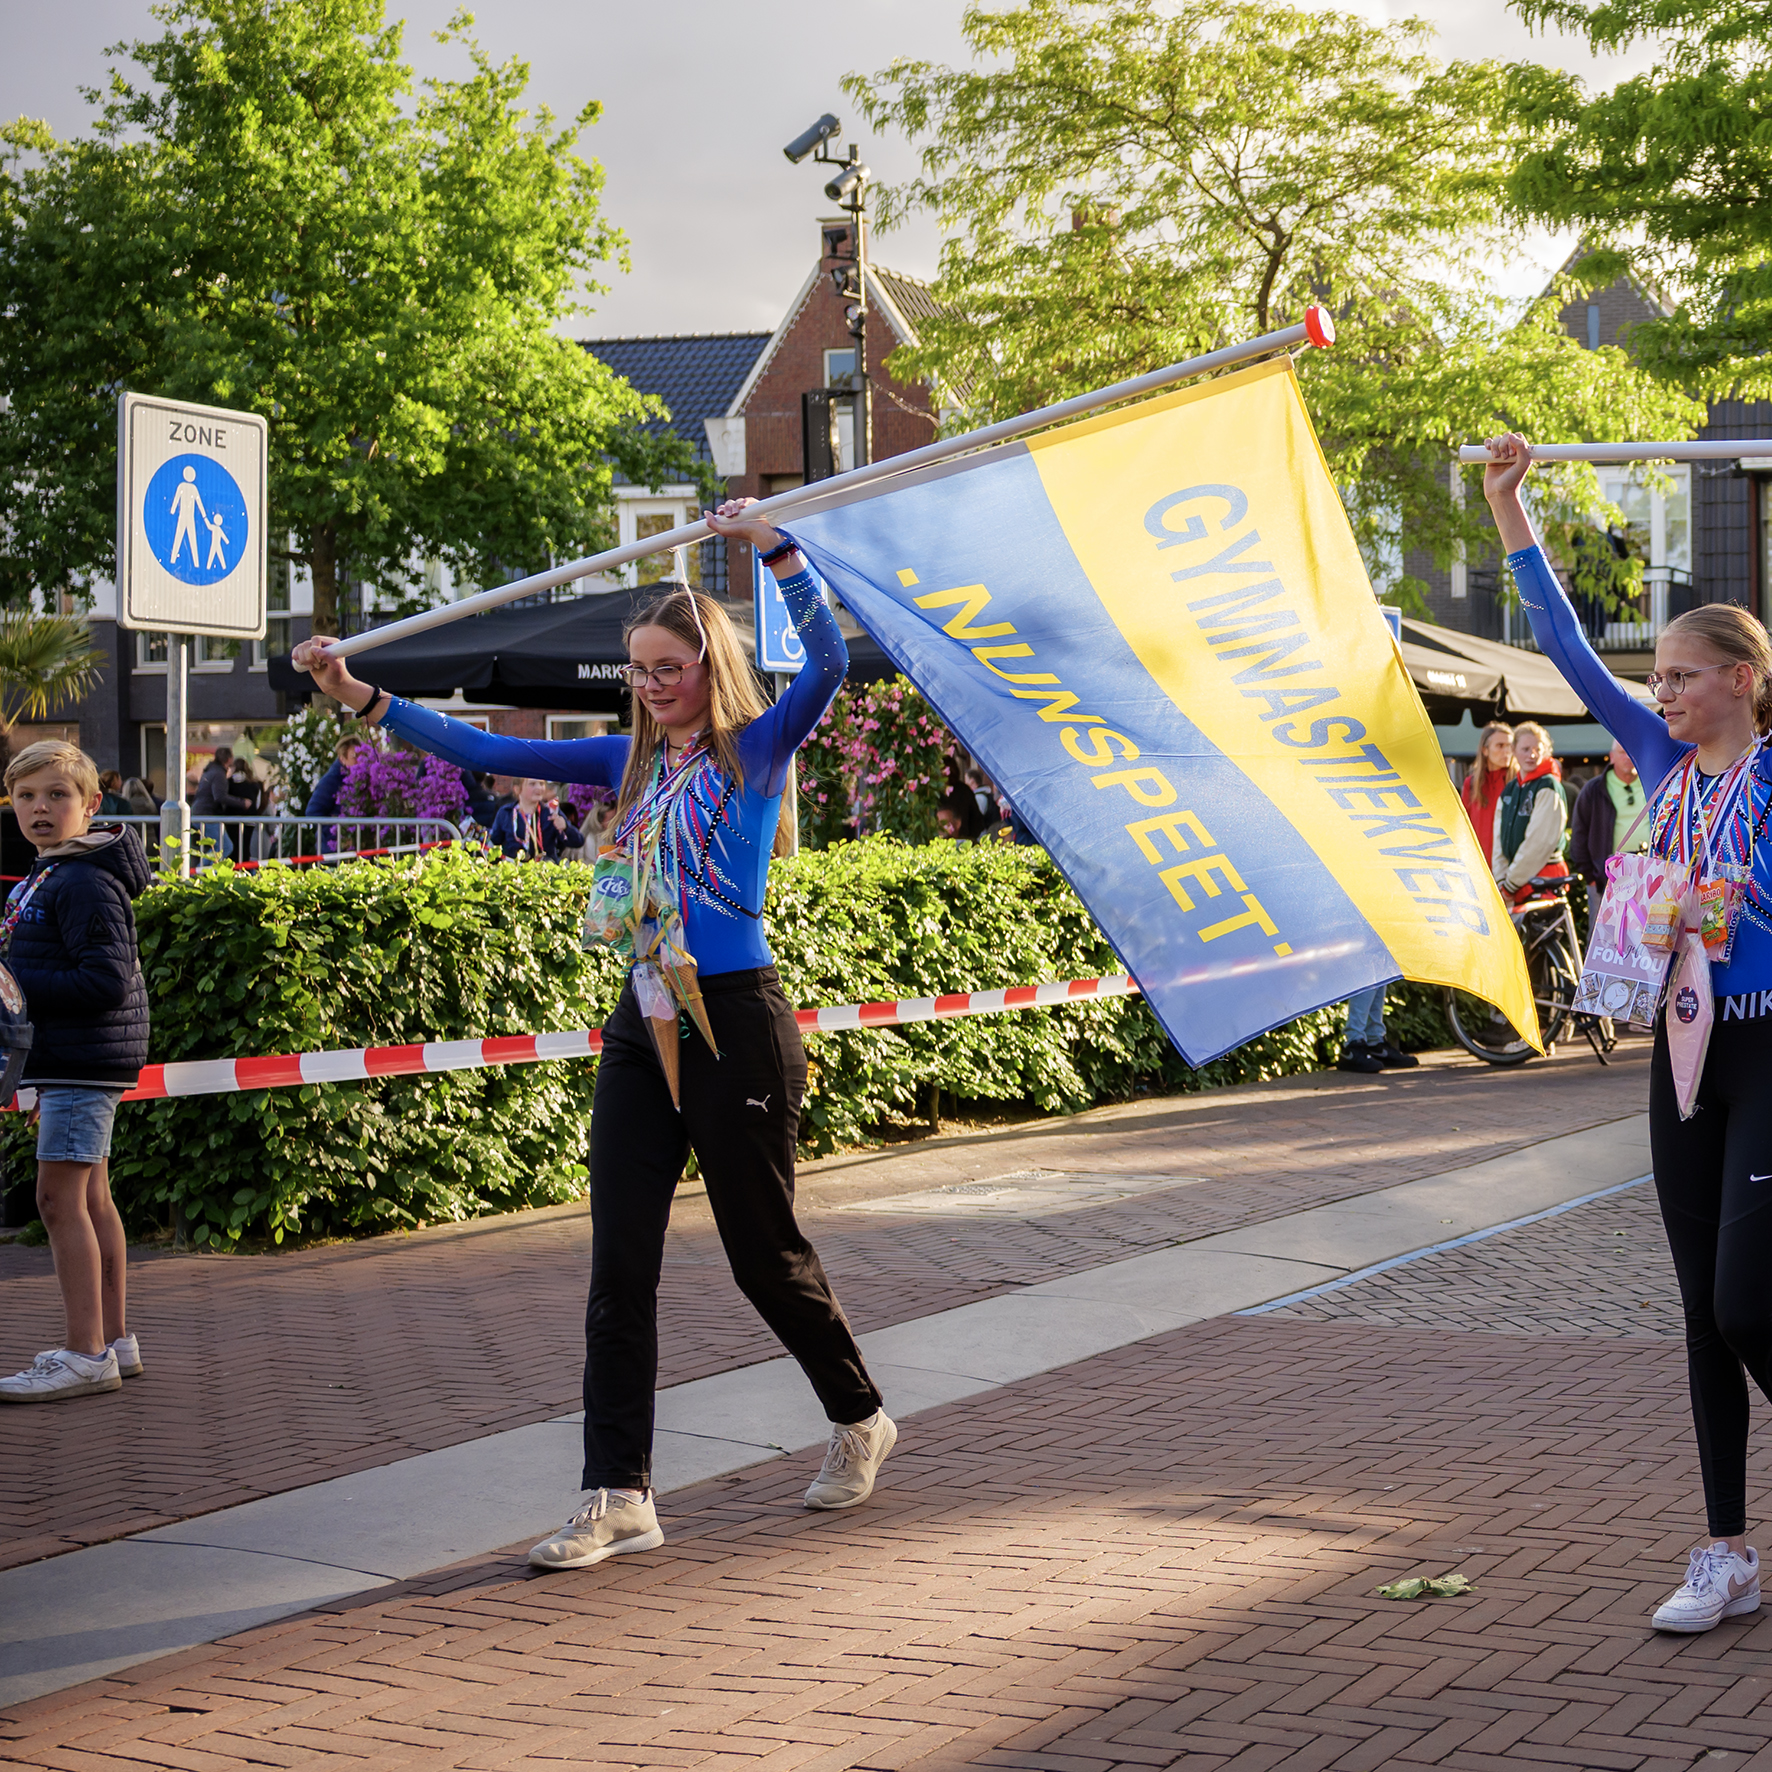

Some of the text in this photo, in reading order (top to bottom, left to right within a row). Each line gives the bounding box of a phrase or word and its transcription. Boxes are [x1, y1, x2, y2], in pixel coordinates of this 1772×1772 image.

[169, 421, 226, 448] ZONE
[577, 663, 628, 679] MARK
[1724, 910, 1738, 957] mentos
[1631, 952, 1665, 973] YOU
